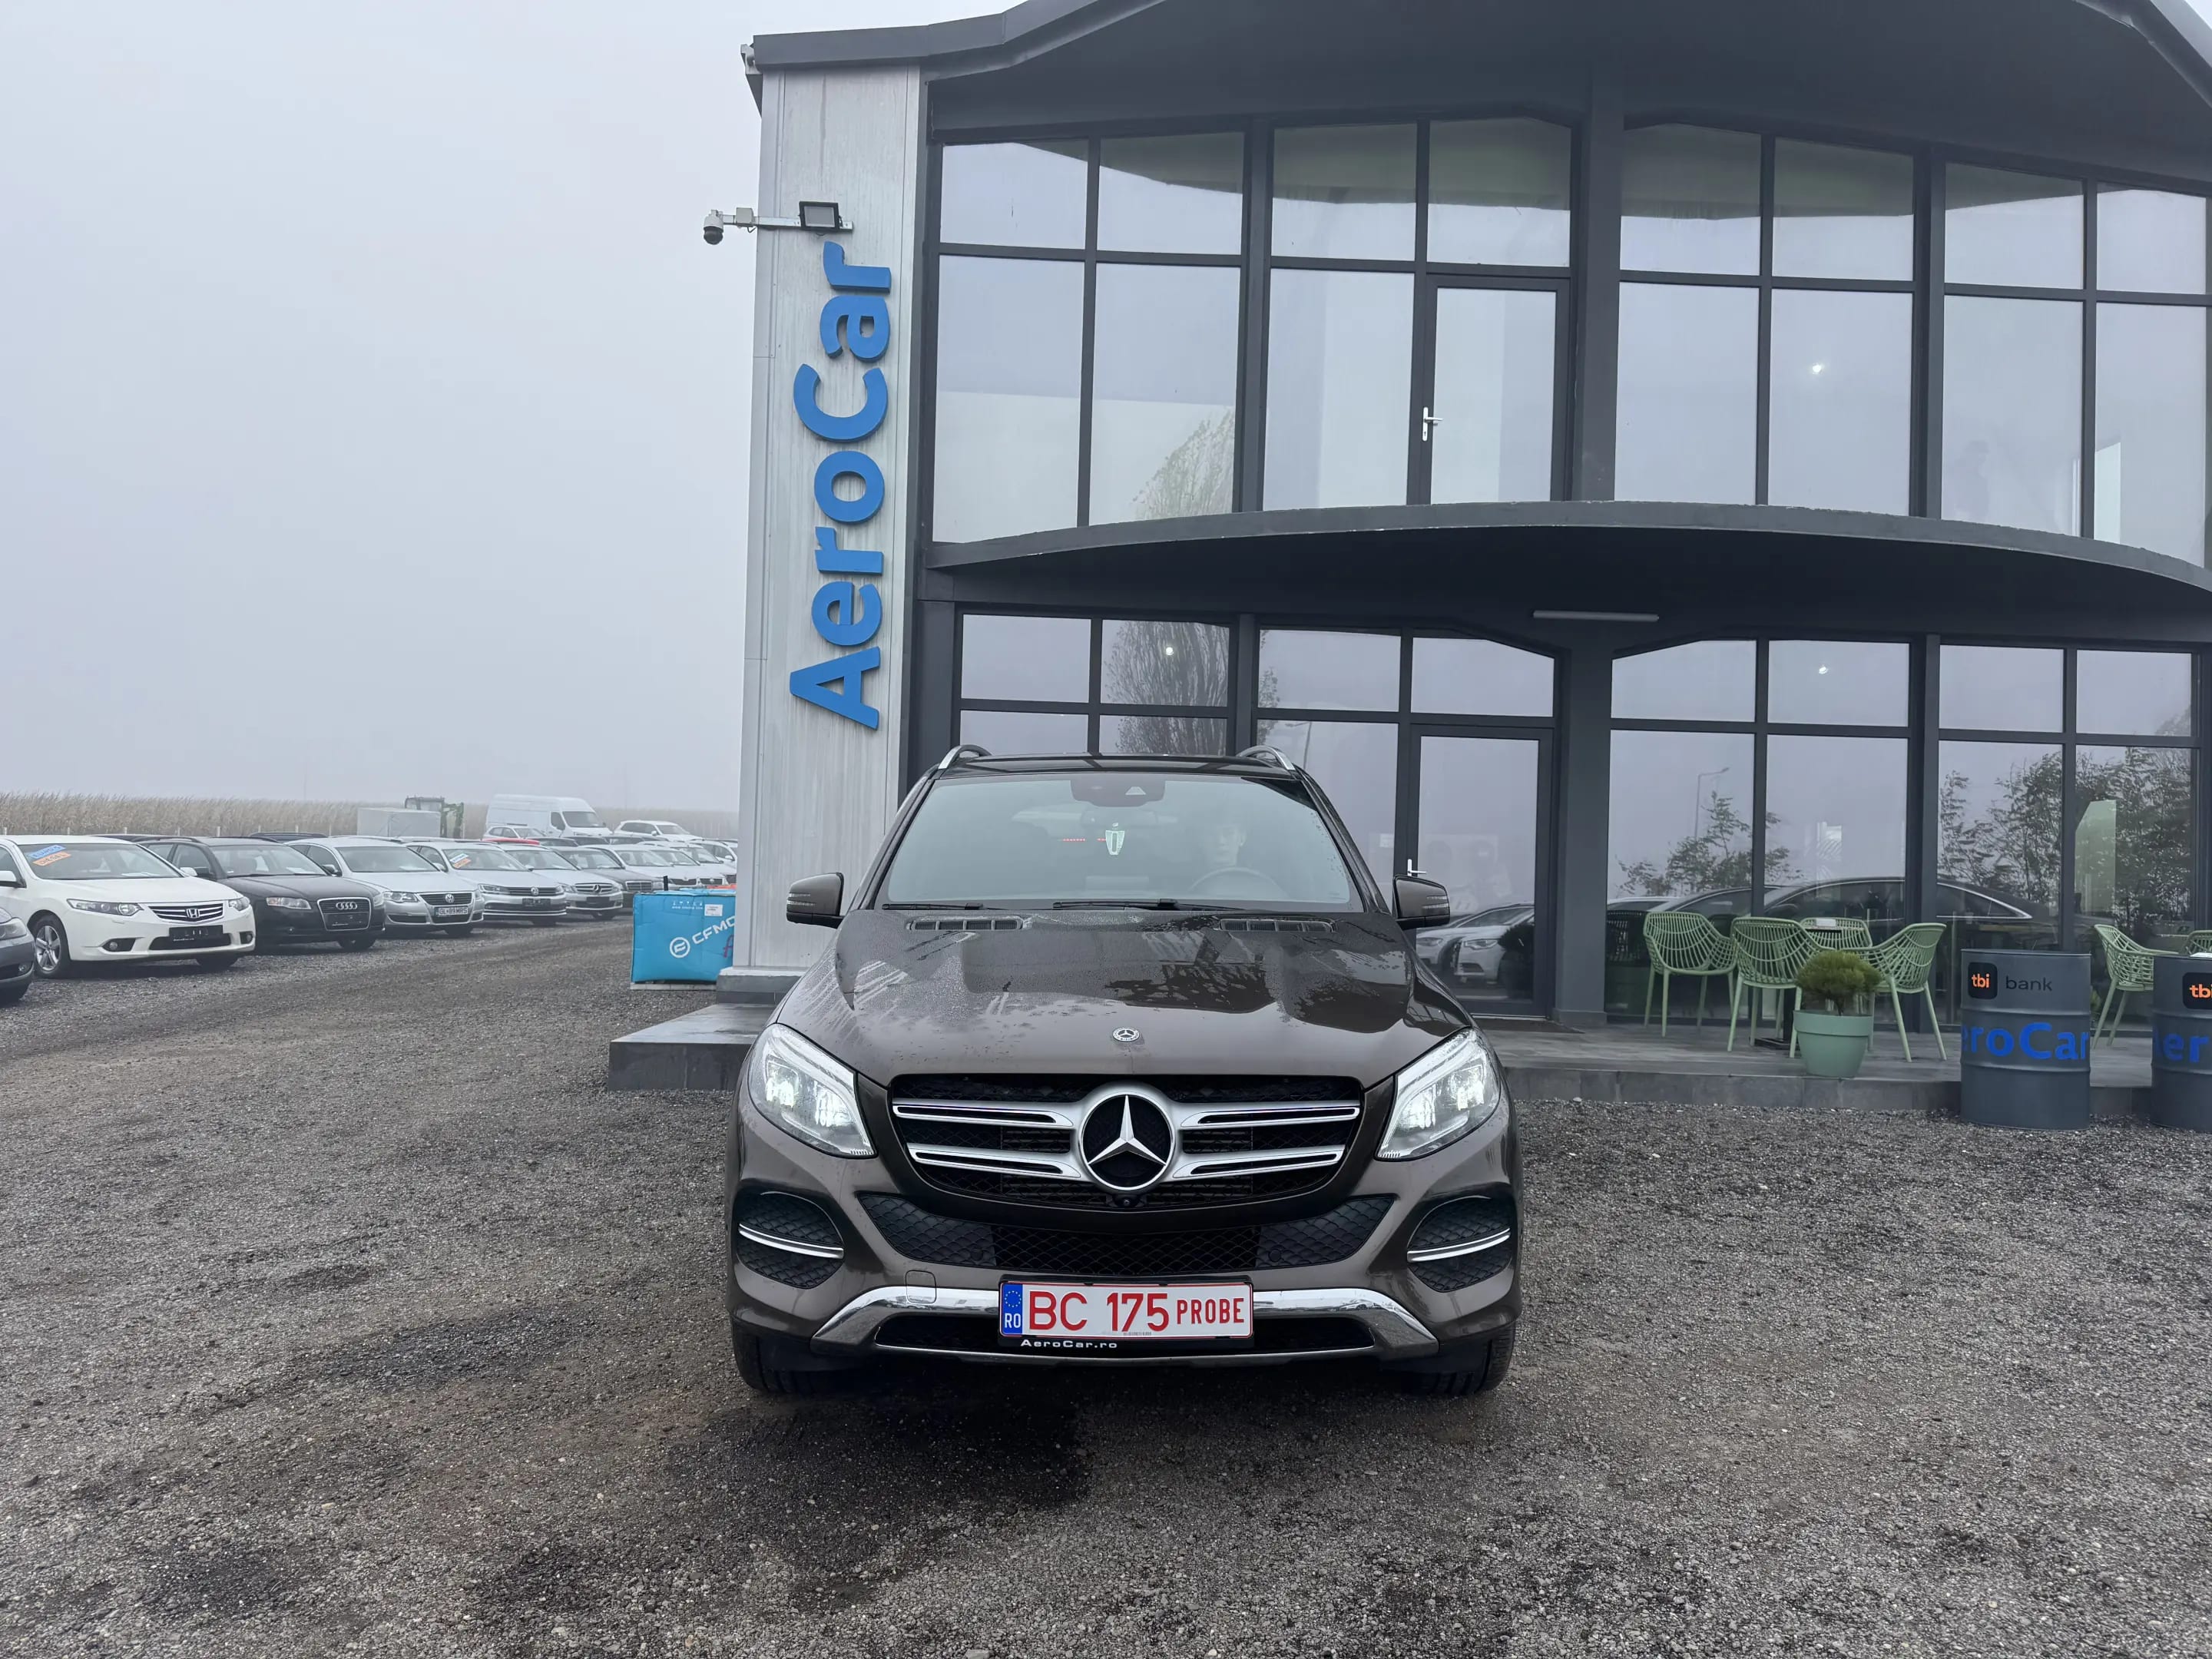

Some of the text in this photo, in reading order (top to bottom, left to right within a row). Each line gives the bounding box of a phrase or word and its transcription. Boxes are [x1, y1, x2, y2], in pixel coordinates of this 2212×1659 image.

[790, 240, 892, 730] AeroCar
[1971, 973, 2052, 992] tbi bank
[1004, 1290, 1244, 1333] RO BC 175 PROBE
[1020, 1339, 1118, 1349] AeroCar.ro
